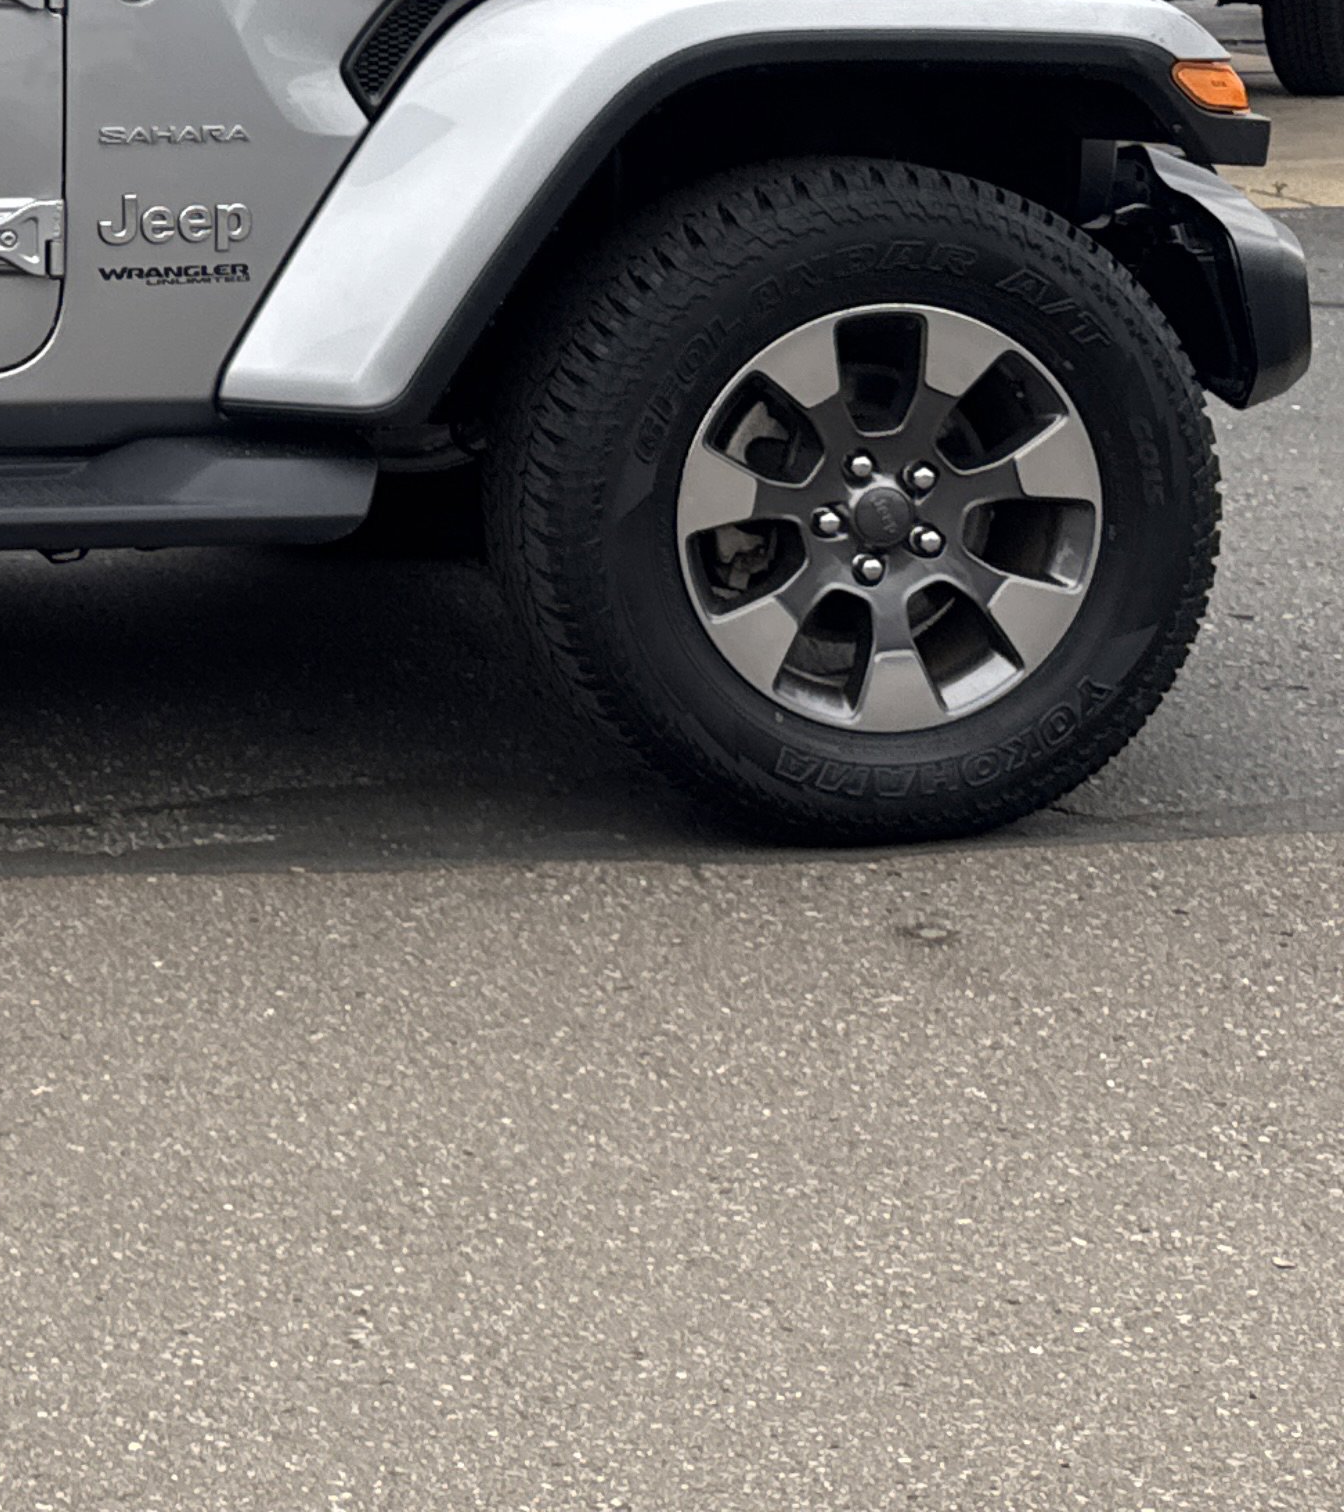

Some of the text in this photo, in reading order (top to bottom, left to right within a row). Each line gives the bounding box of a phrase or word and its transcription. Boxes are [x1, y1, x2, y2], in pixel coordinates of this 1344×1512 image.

[97, 123, 251, 146] SAHARA
[97, 192, 253, 254] Jeep
[97, 262, 250, 281] WRANGLER
[996, 268, 1113, 349] A/T
[775, 674, 1117, 795] YOKOHAMA
